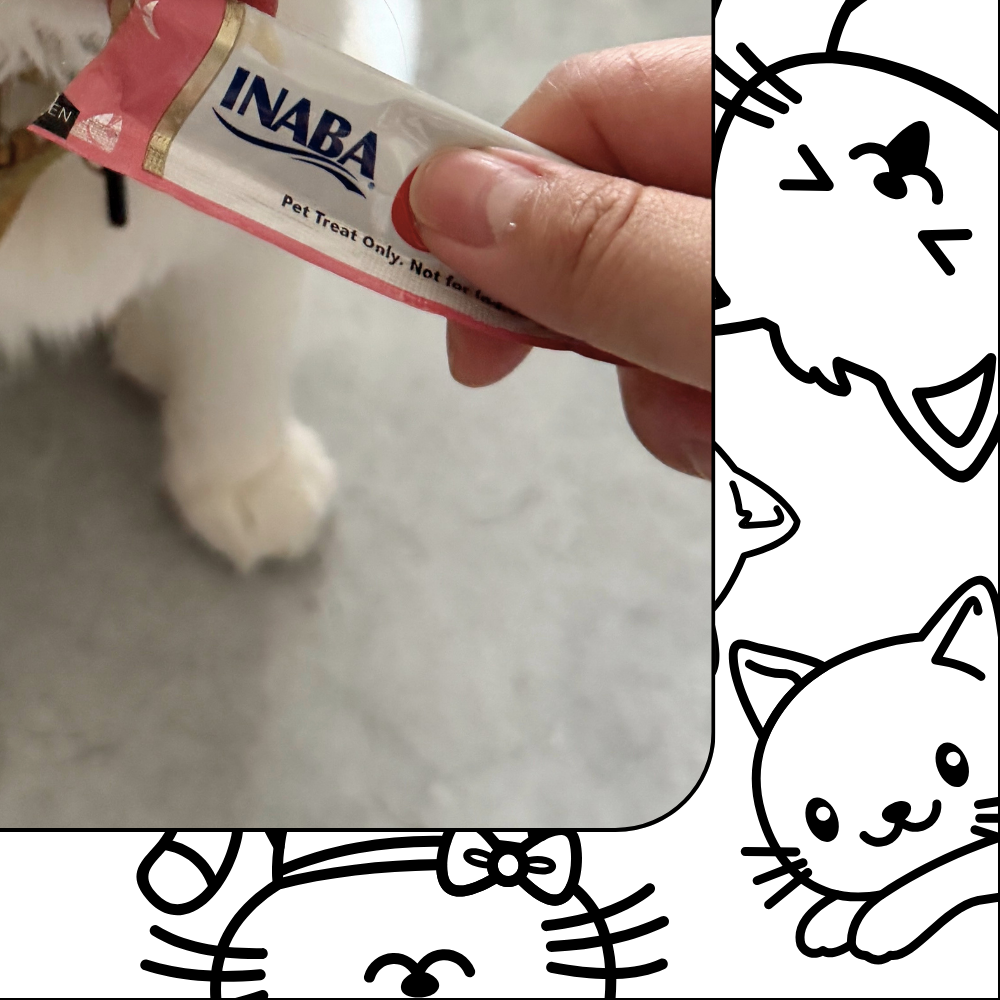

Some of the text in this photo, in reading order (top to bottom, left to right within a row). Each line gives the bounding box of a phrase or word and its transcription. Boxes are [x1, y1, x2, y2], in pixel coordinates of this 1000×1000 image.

[219, 66, 377, 181] INABA
[281, 194, 470, 296] Pet Treat Only. Not for
